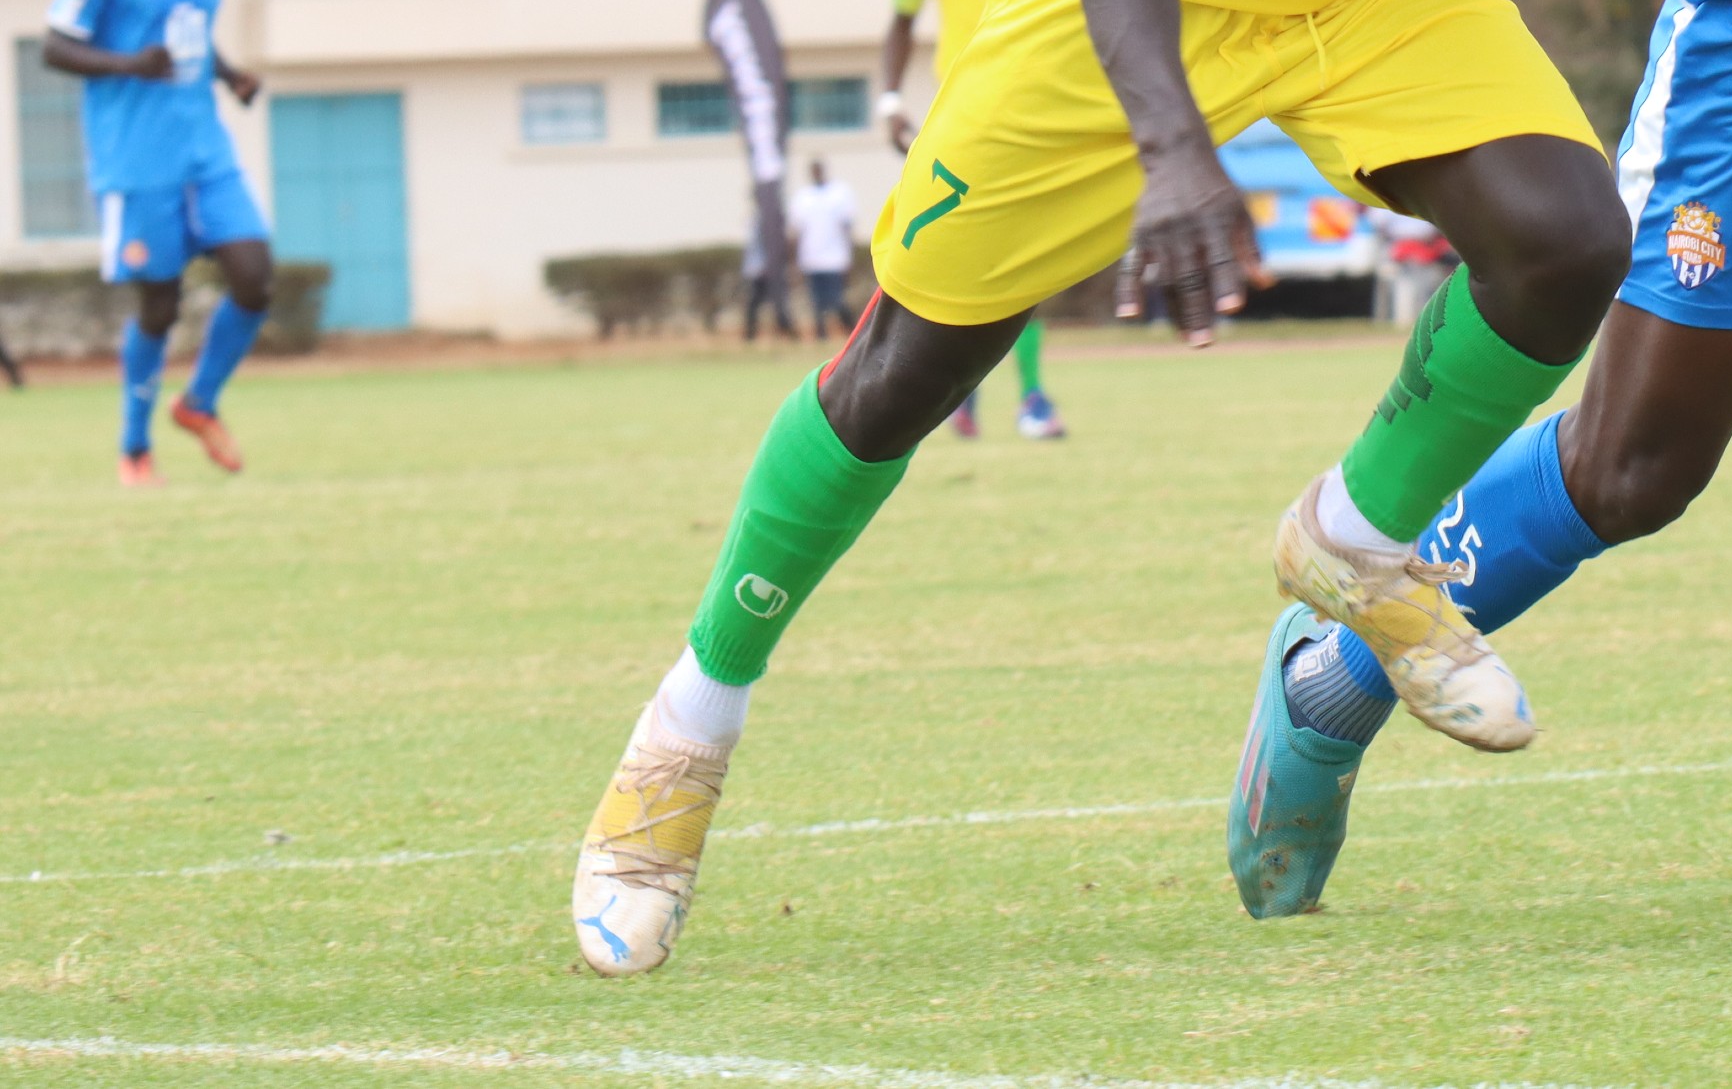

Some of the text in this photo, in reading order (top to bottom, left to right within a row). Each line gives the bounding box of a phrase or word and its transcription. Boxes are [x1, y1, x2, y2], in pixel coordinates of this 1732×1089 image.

[901, 158, 969, 250] 7
[1668, 235, 1722, 262] NAIROBI CITY
